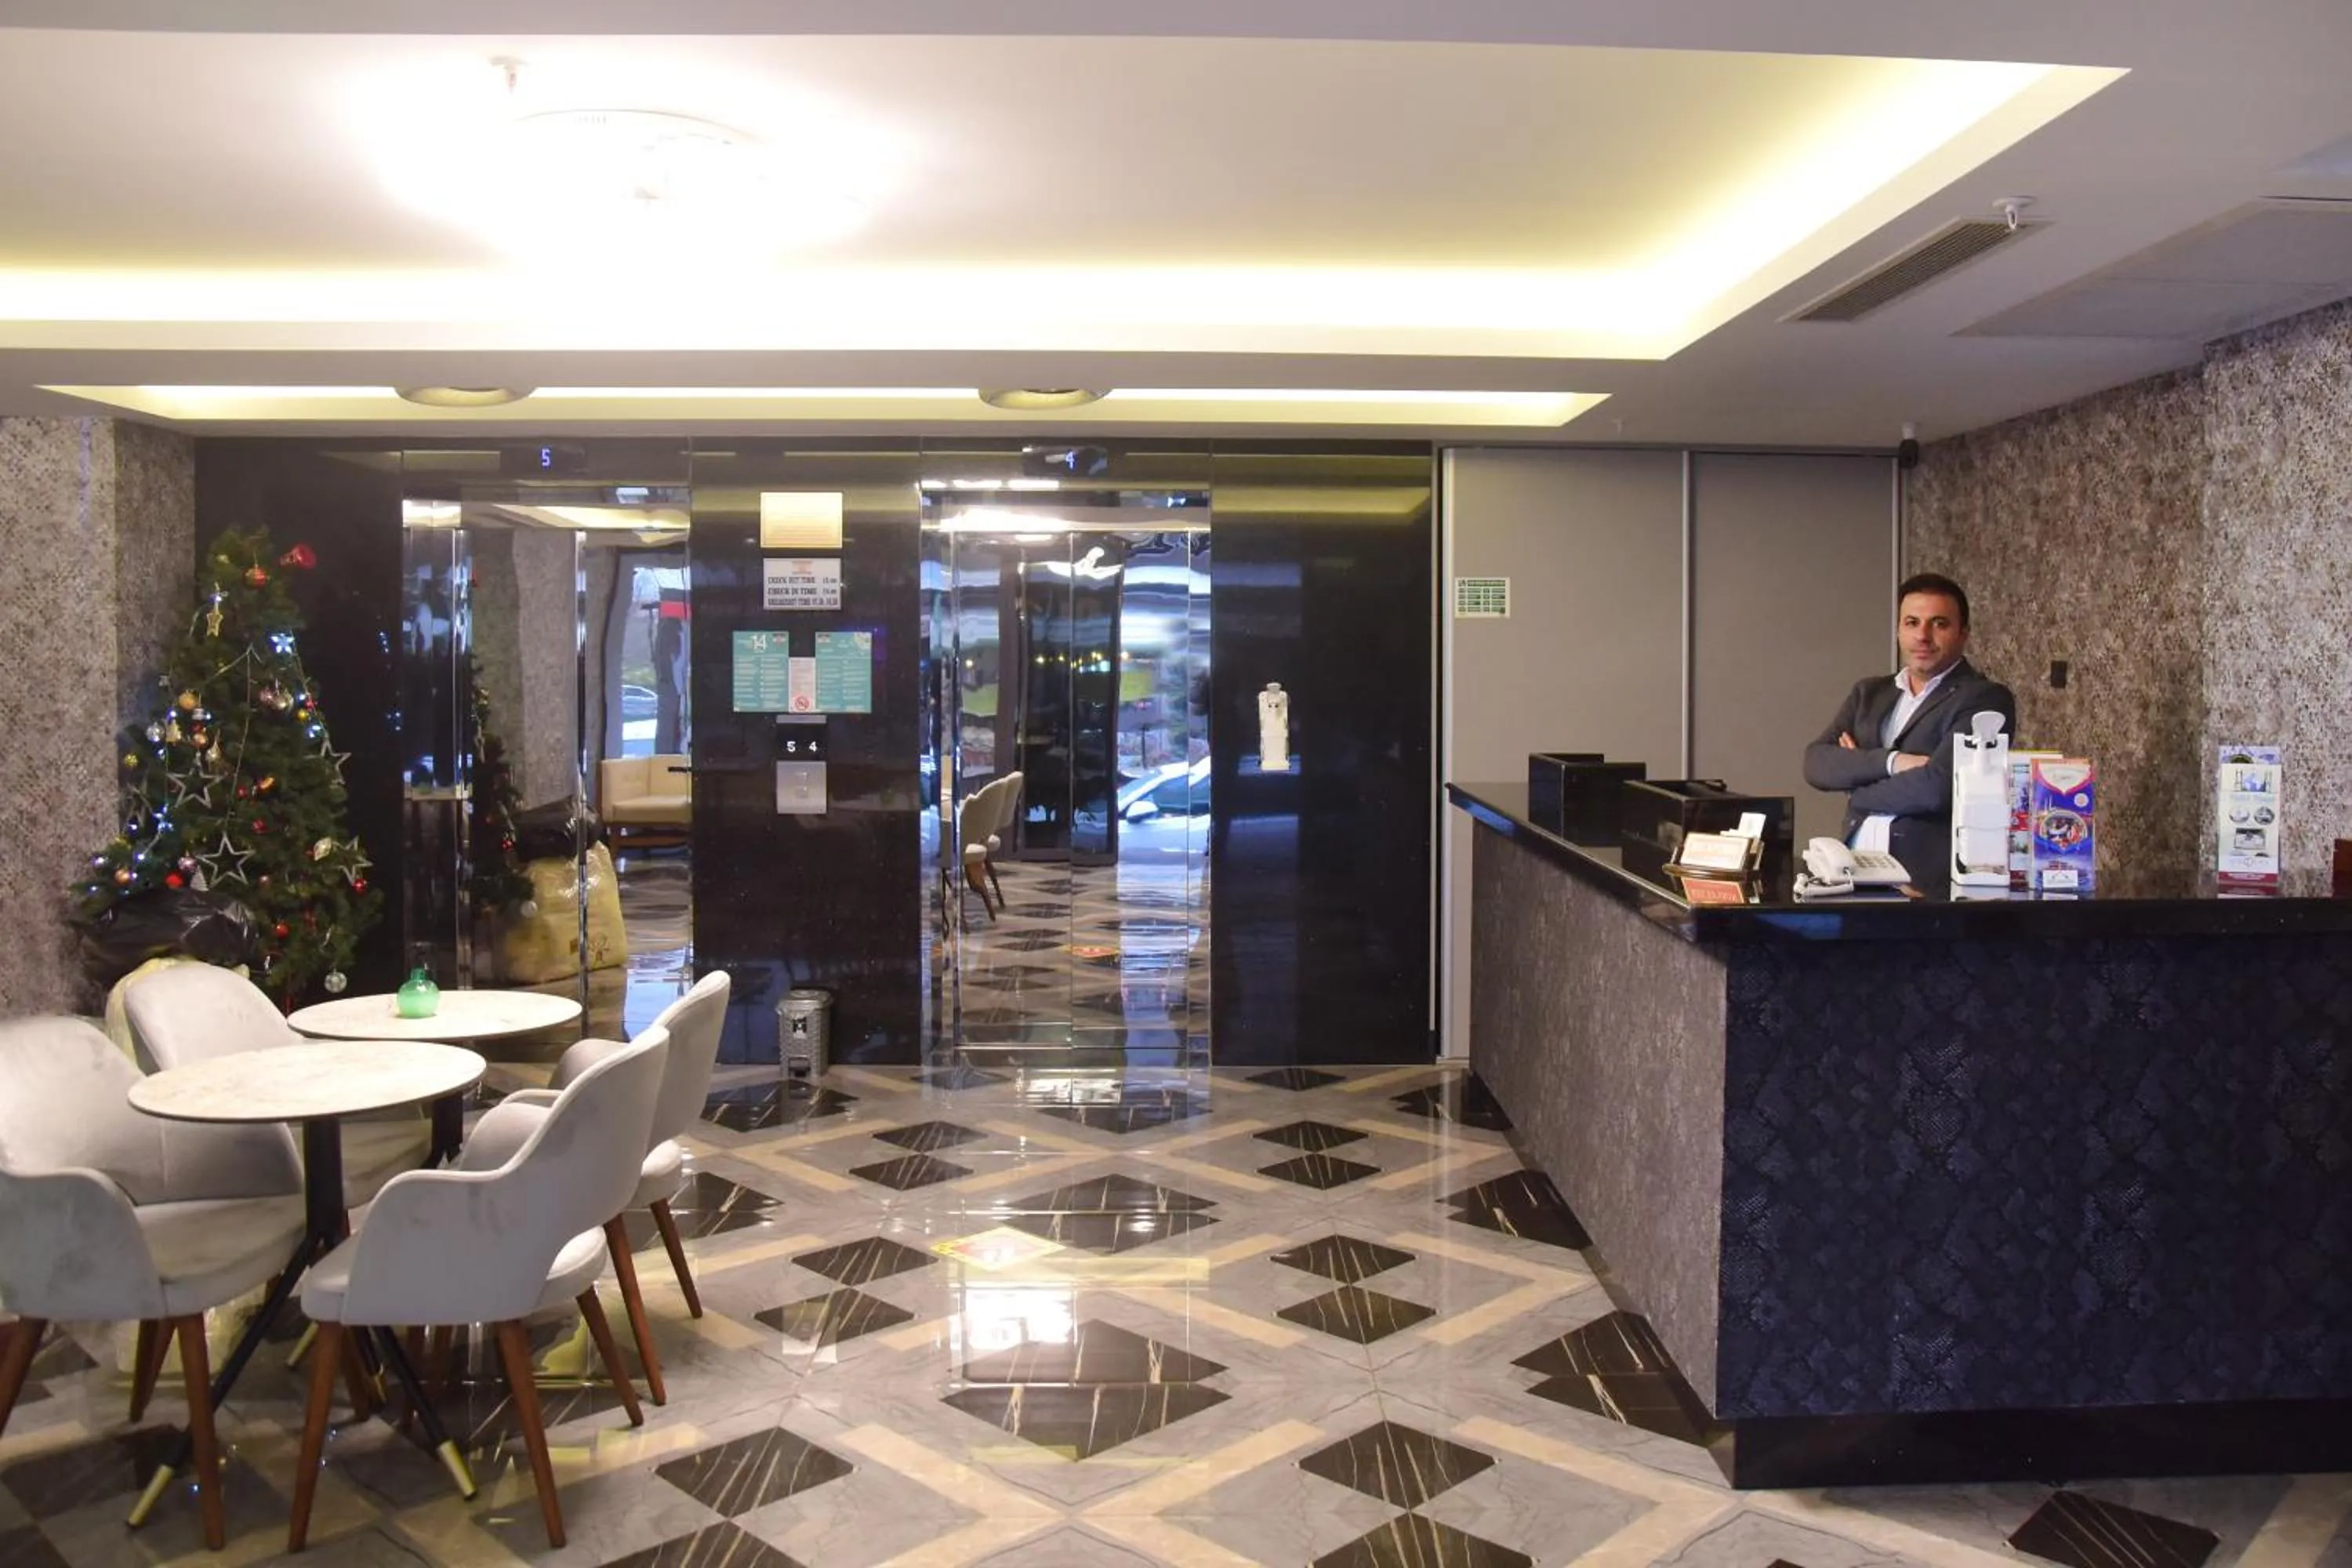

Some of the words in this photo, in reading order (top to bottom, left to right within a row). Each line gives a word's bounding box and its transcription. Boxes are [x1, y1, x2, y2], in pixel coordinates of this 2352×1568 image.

[541, 448, 550, 466] 5
[1065, 451, 1076, 470] 4
[750, 634, 766, 650] 14
[786, 741, 796, 753] 5
[808, 741, 817, 752] 4
